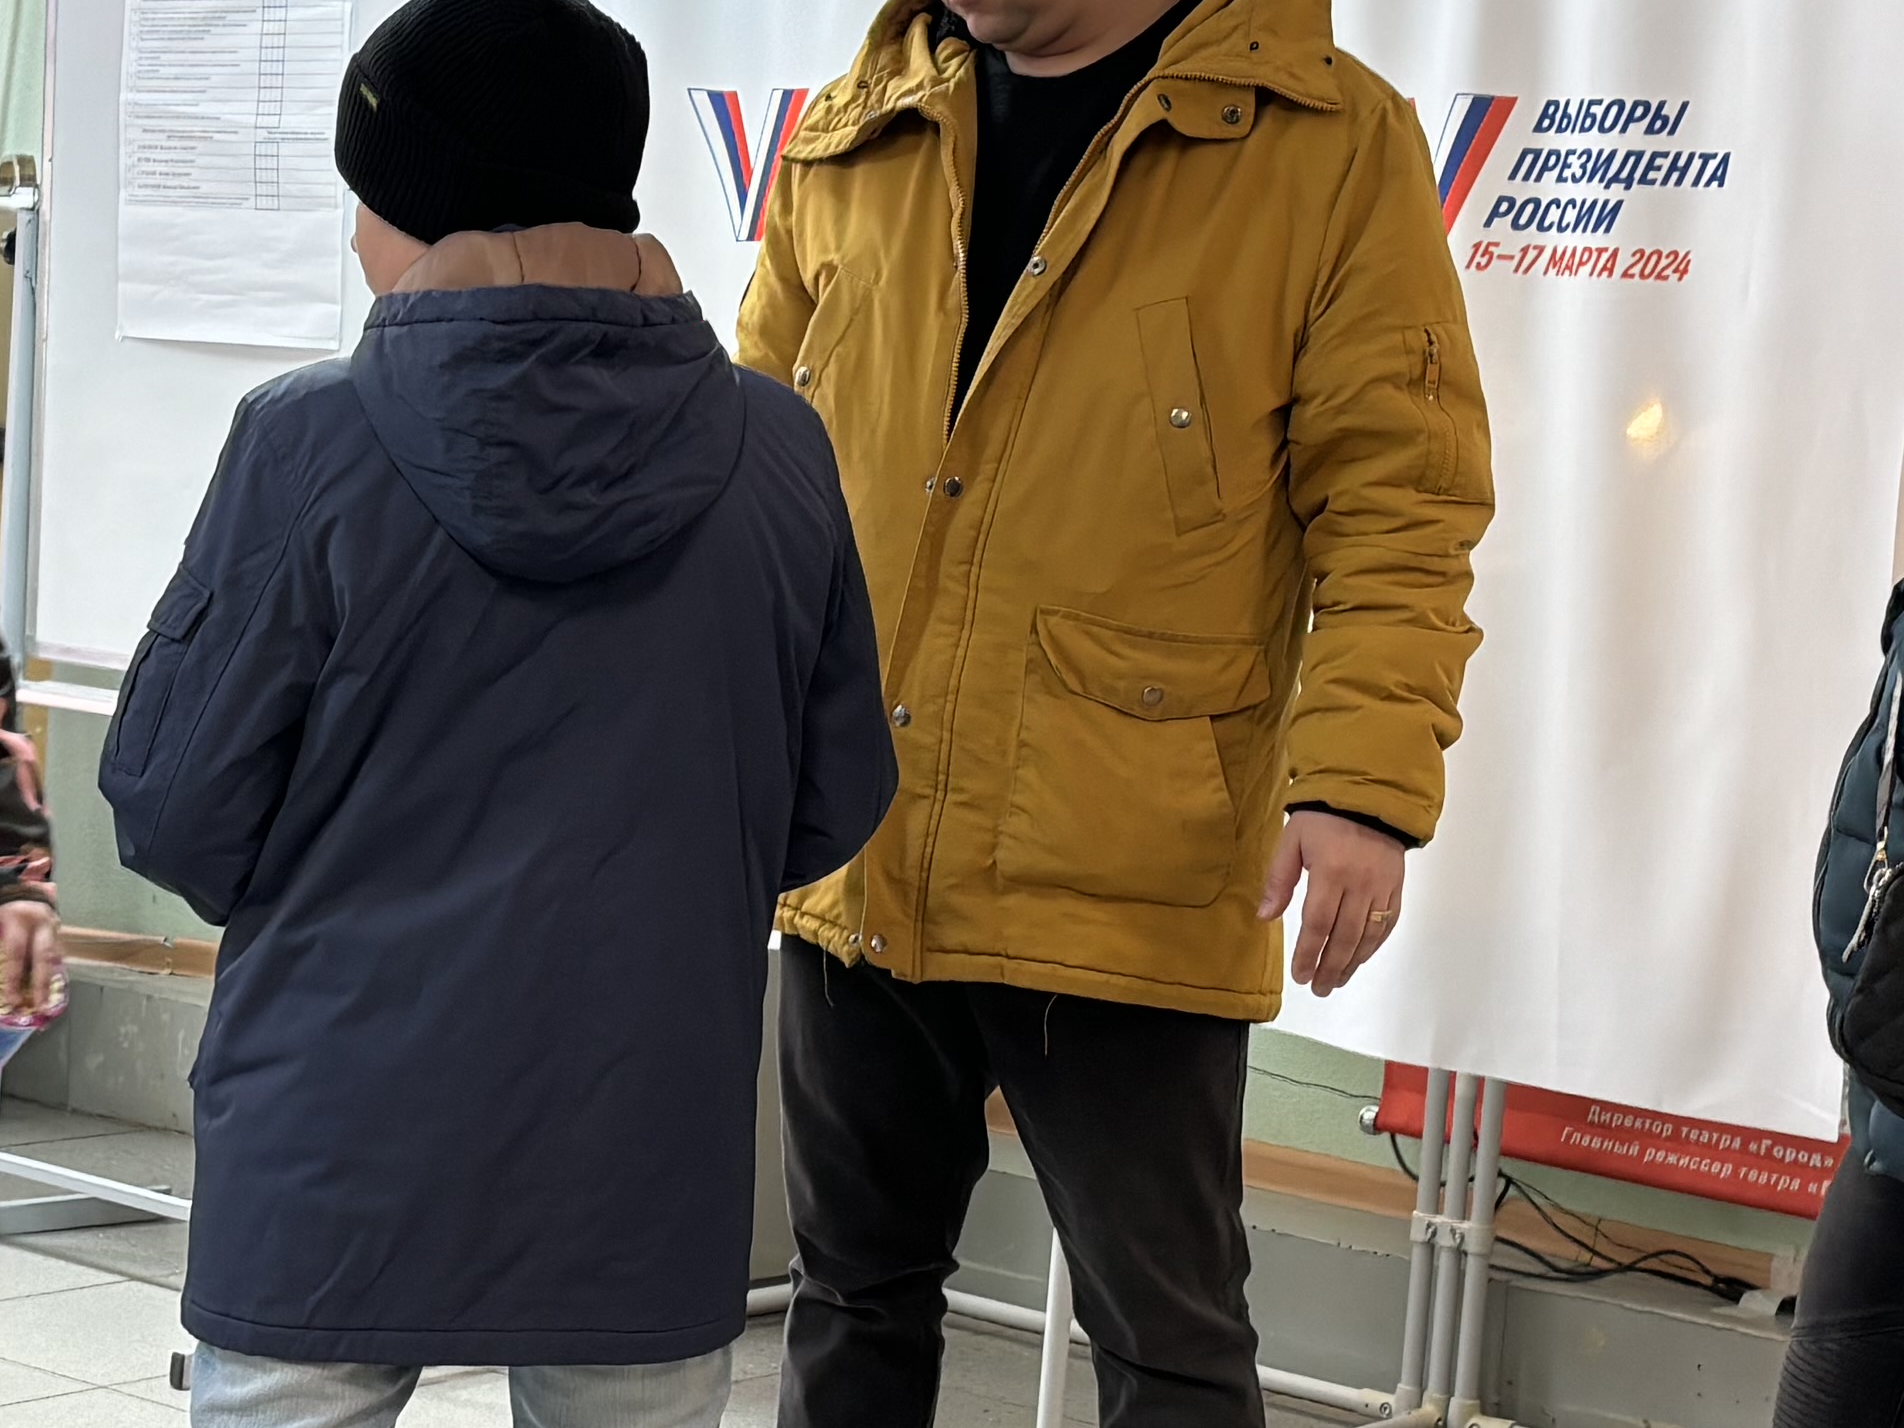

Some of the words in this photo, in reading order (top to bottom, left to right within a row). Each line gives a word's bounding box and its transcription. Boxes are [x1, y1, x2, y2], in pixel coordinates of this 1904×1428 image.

[1532, 98, 1690, 136] ВЫБОРЫ
[1508, 147, 1731, 191] ПРЕЗИДЕНТА
[1483, 195, 1624, 234] РОССИИ
[1544, 245, 1620, 278] МАРТА
[1621, 248, 1692, 282] 2024
[1587, 1105, 1673, 1137] Директор
[1680, 1126, 1742, 1151] театра
[1561, 1126, 1639, 1157] Главный
[1643, 1147, 1733, 1179] режиссер
[1739, 1165, 1800, 1192] театра
